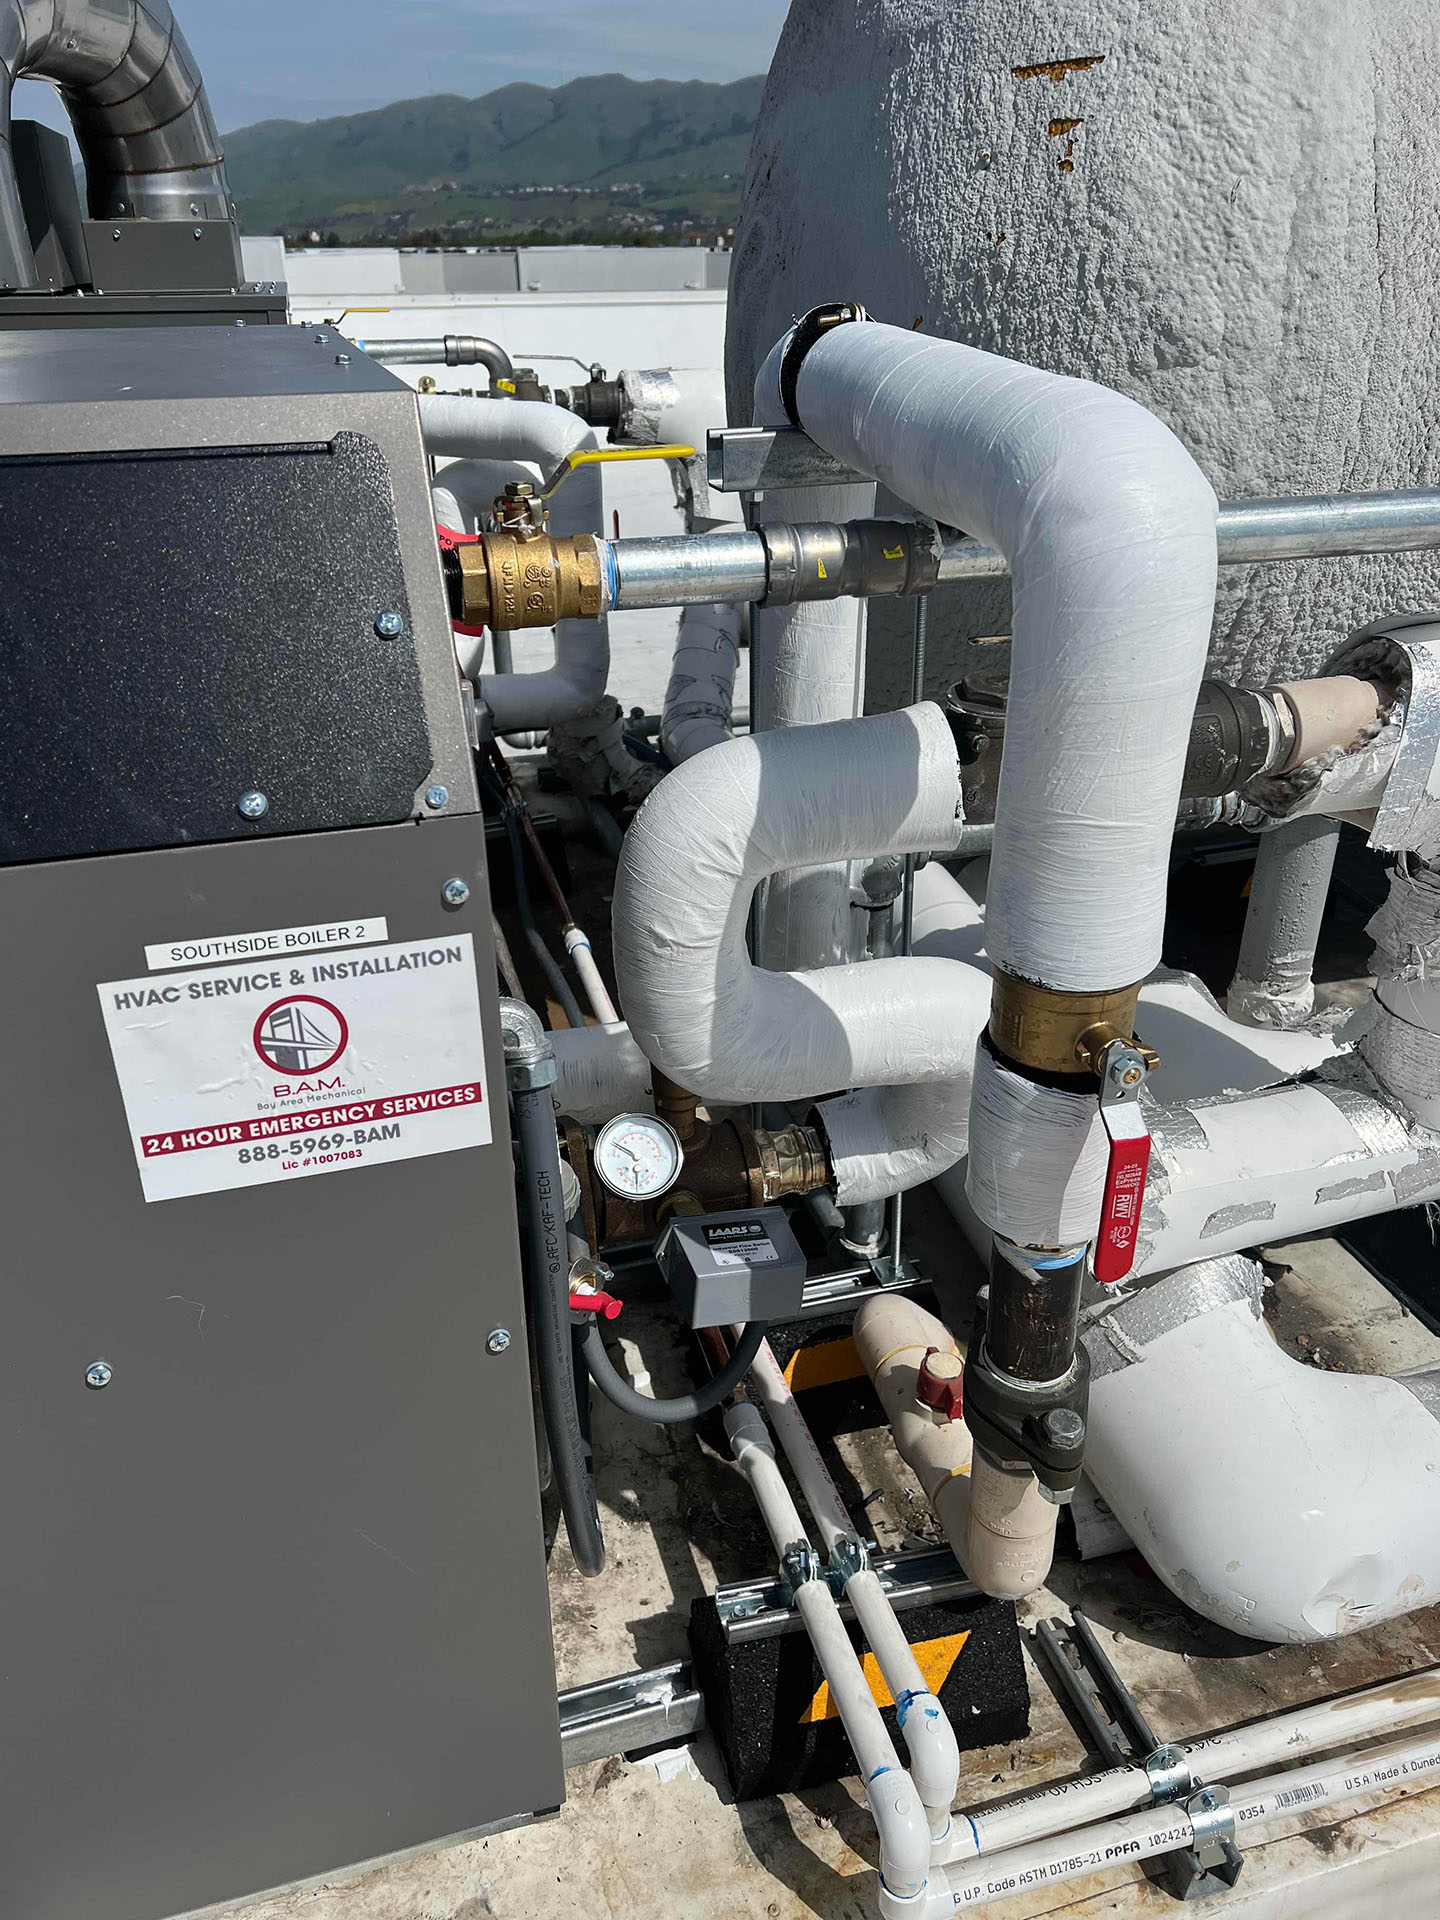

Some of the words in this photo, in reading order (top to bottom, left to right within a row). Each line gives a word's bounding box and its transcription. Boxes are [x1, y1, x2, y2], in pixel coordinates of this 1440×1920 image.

[170, 936, 280, 962] SOUTHSIDE
[285, 926, 352, 948] BOILER
[355, 925, 366, 939] 2
[114, 986, 181, 1010] HVAC
[189, 971, 282, 1000] SERVICE
[289, 970, 306, 986] &
[312, 946, 463, 983] INSTALLATION
[256, 1100, 276, 1111] Bay
[280, 1096, 304, 1108] Area
[306, 1086, 366, 1104] Mechanical
[273, 1076, 346, 1098] B.A.M.
[146, 1138, 175, 1154] 24
[180, 1126, 243, 1149] HOUR
[248, 1104, 376, 1138] EMERGENCY
[382, 1087, 476, 1116] SERVICES
[238, 1123, 401, 1164] 888-5969-BAM
[282, 1160, 299, 1171] Lic
[302, 1149, 363, 1168] #1007083
[1115, 1194, 1130, 1218] RWV
[708, 1226, 748, 1237] LAARS
[1374, 1768, 1400, 1782] Made
[1402, 1763, 1408, 1774] &
[1410, 1754, 1440, 1772] Owned
[1048, 1786, 1068, 1797] 40
[987, 1878, 1016, 1894] Code
[1019, 1867, 1048, 1884] ASTM
[1050, 1852, 1103, 1876] D1785-21
[1105, 1840, 1142, 1860] PPFA
[1238, 1804, 1266, 1822] 0354
